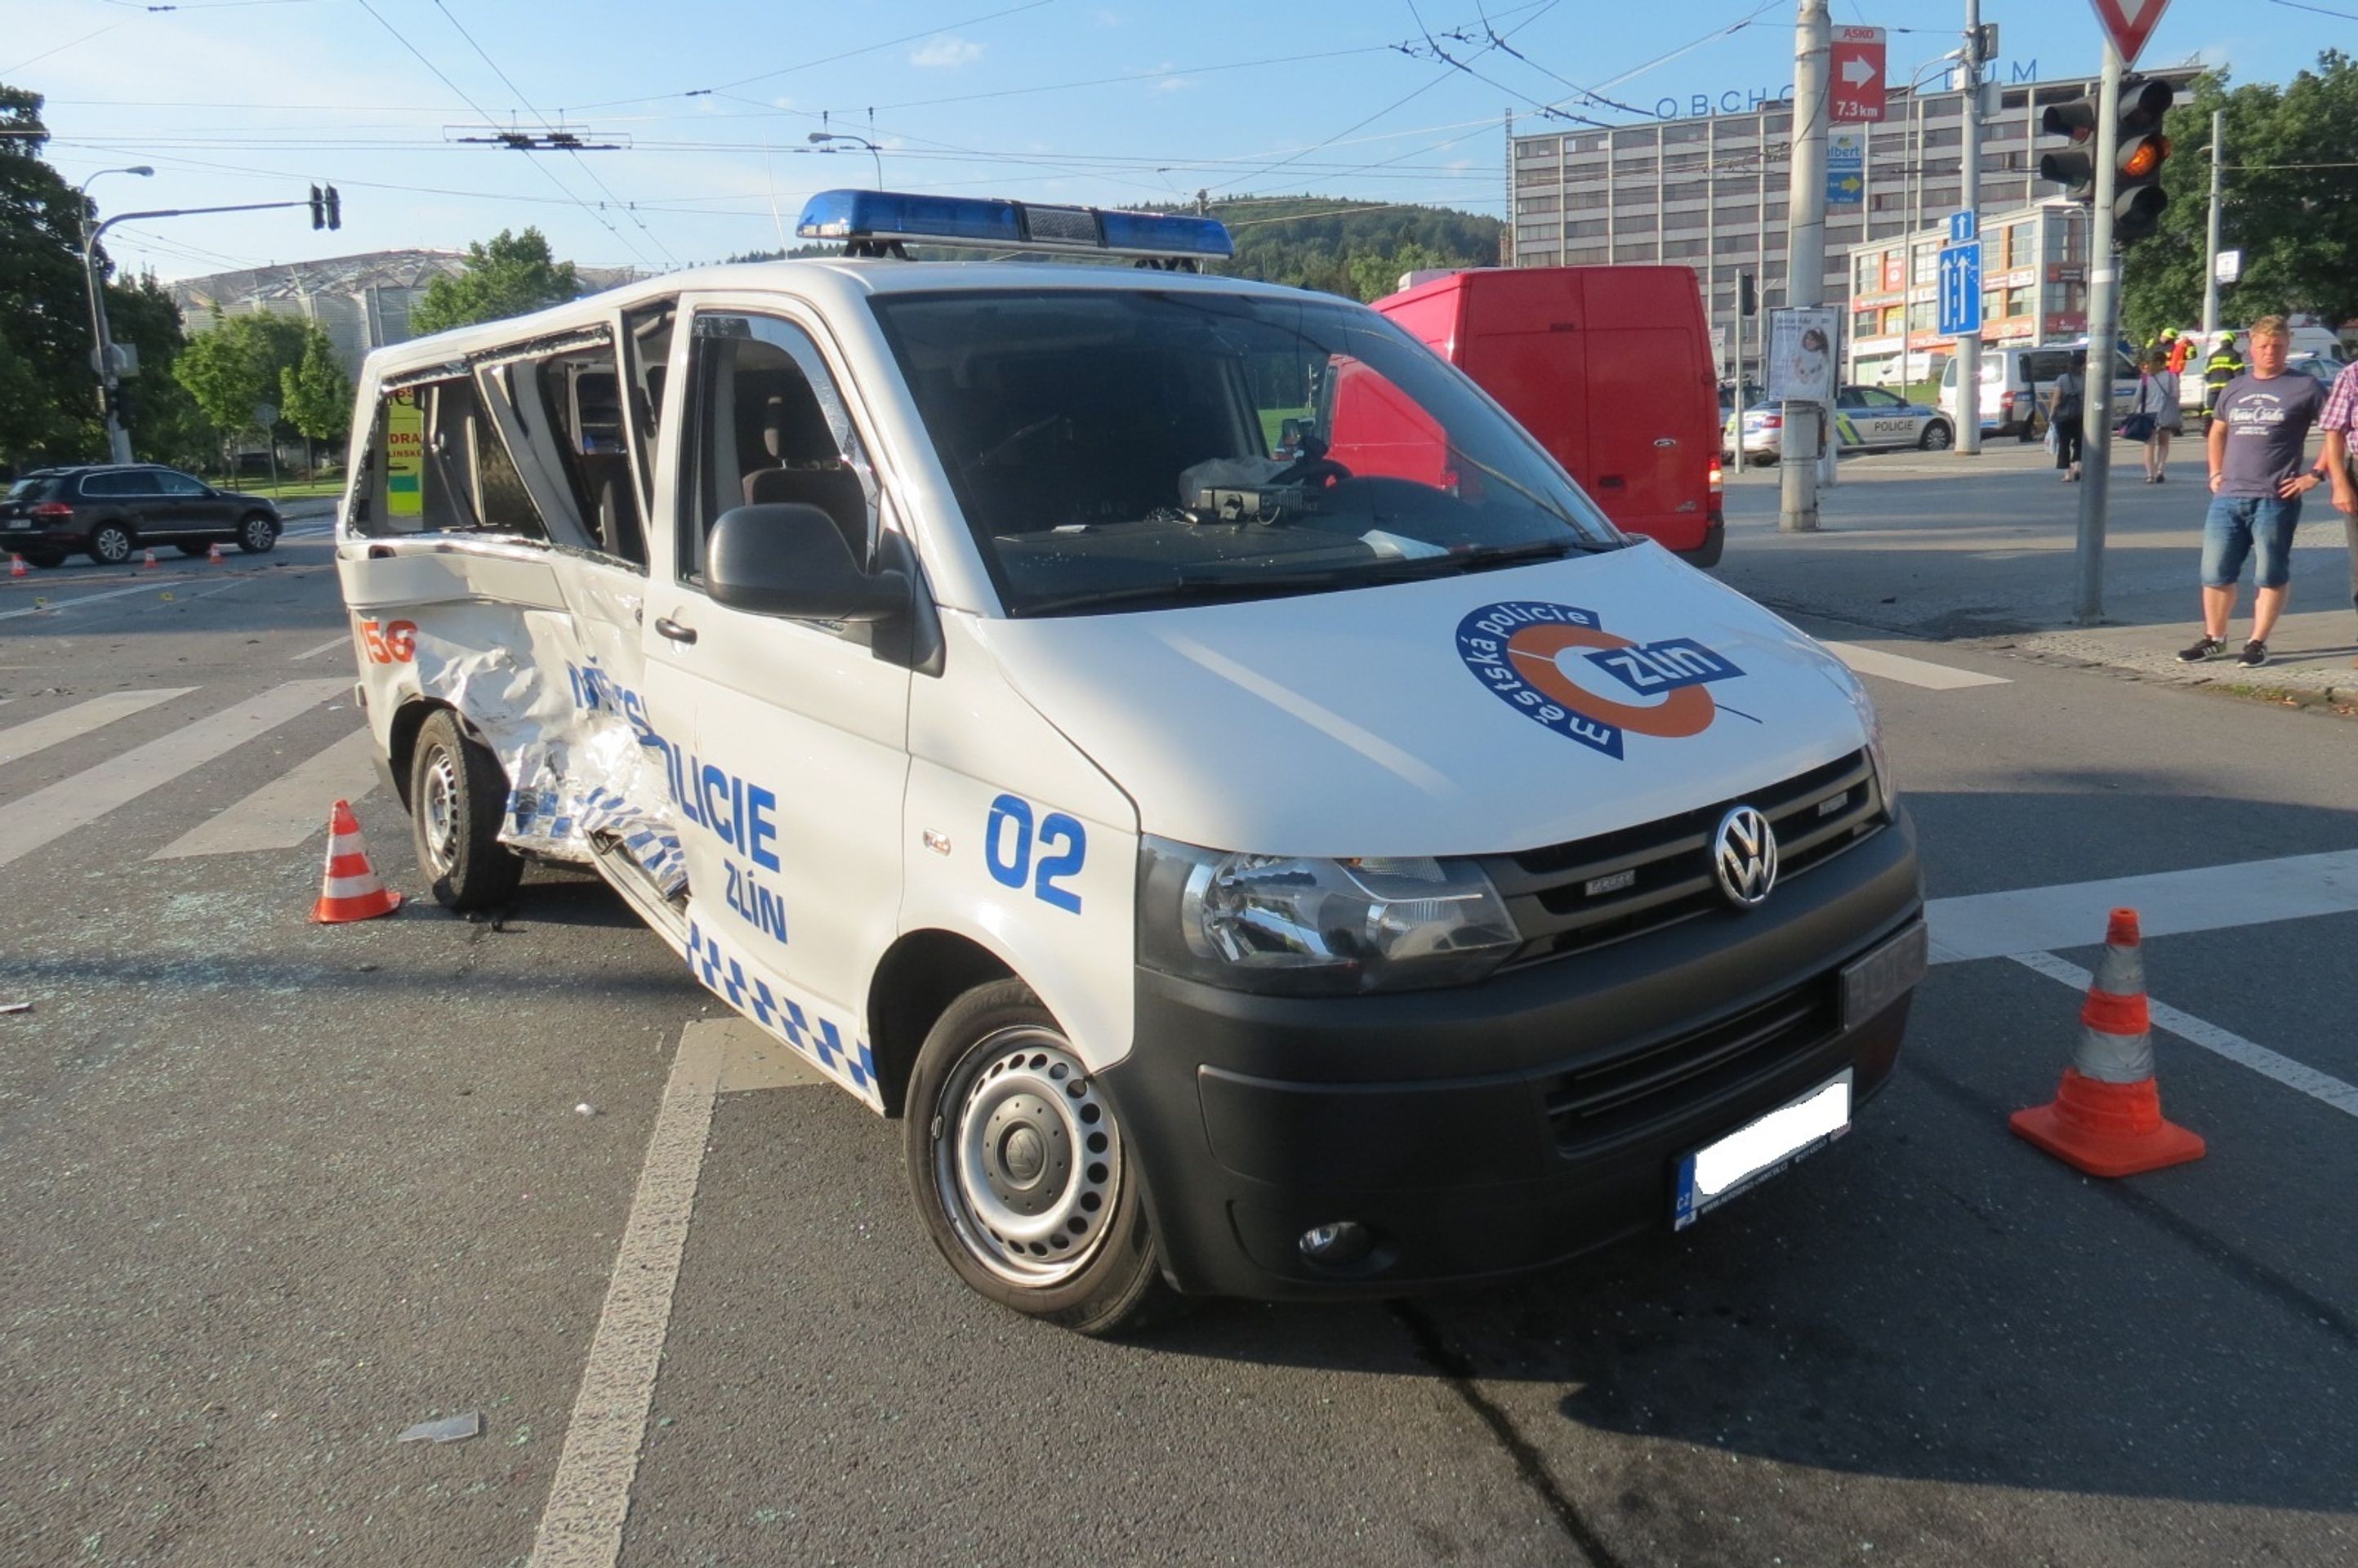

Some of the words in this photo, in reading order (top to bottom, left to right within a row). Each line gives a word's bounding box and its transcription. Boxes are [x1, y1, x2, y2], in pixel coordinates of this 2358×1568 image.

[1837, 101, 1858, 117] 7.3
[1860, 104, 1878, 117] km
[1874, 420, 1914, 431] POLICIE
[1475, 604, 1590, 638] policie
[986, 793, 1087, 915] 02
[724, 858, 788, 945] ZLÍN
